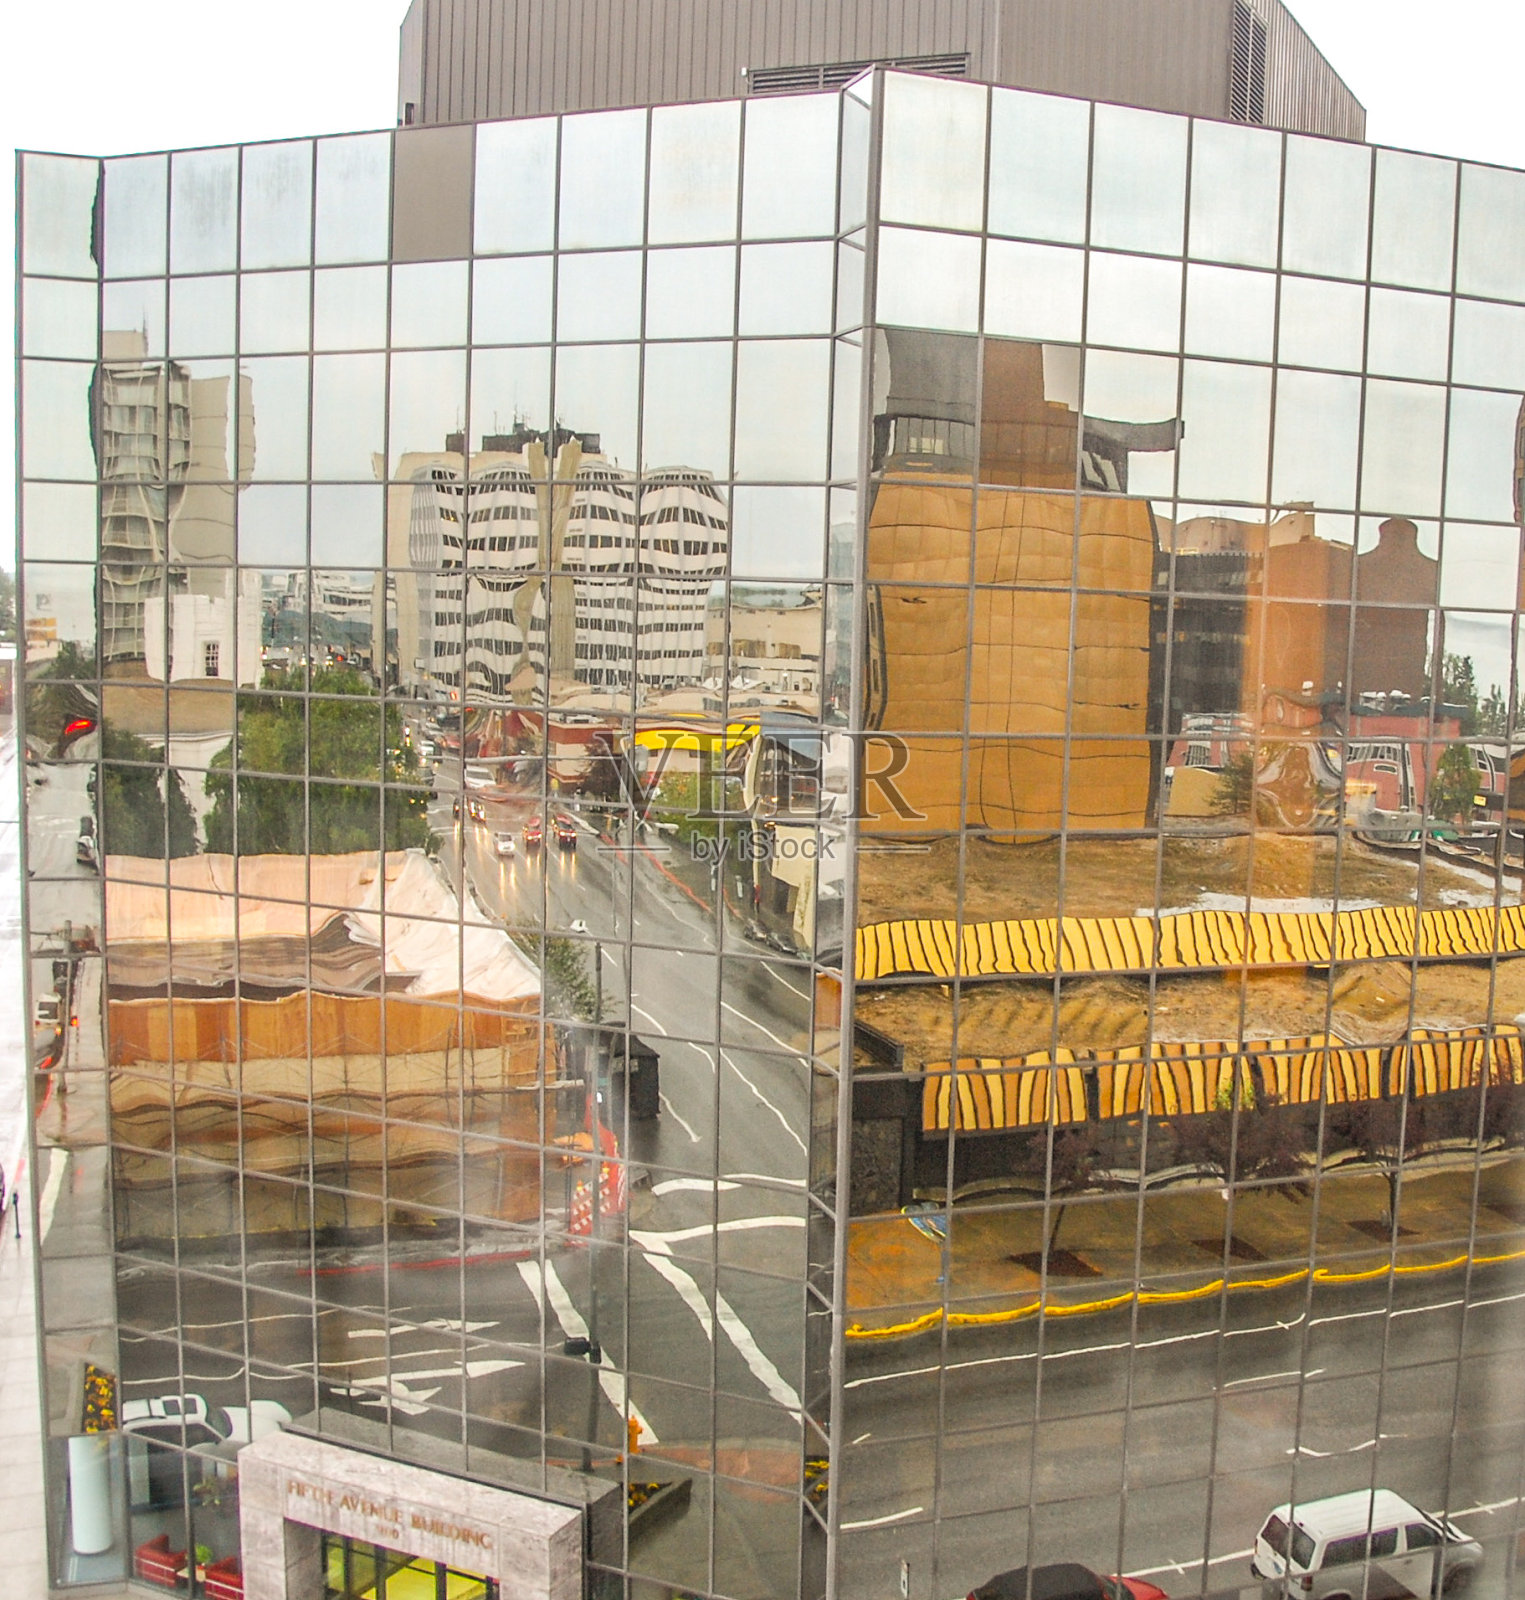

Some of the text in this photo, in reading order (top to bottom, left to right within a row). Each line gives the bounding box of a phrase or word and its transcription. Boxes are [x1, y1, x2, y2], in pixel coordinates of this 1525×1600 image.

[287, 1479, 332, 1505] FIFTH
[340, 1494, 402, 1523] AVENUE
[411, 1512, 492, 1549] BUILDING
